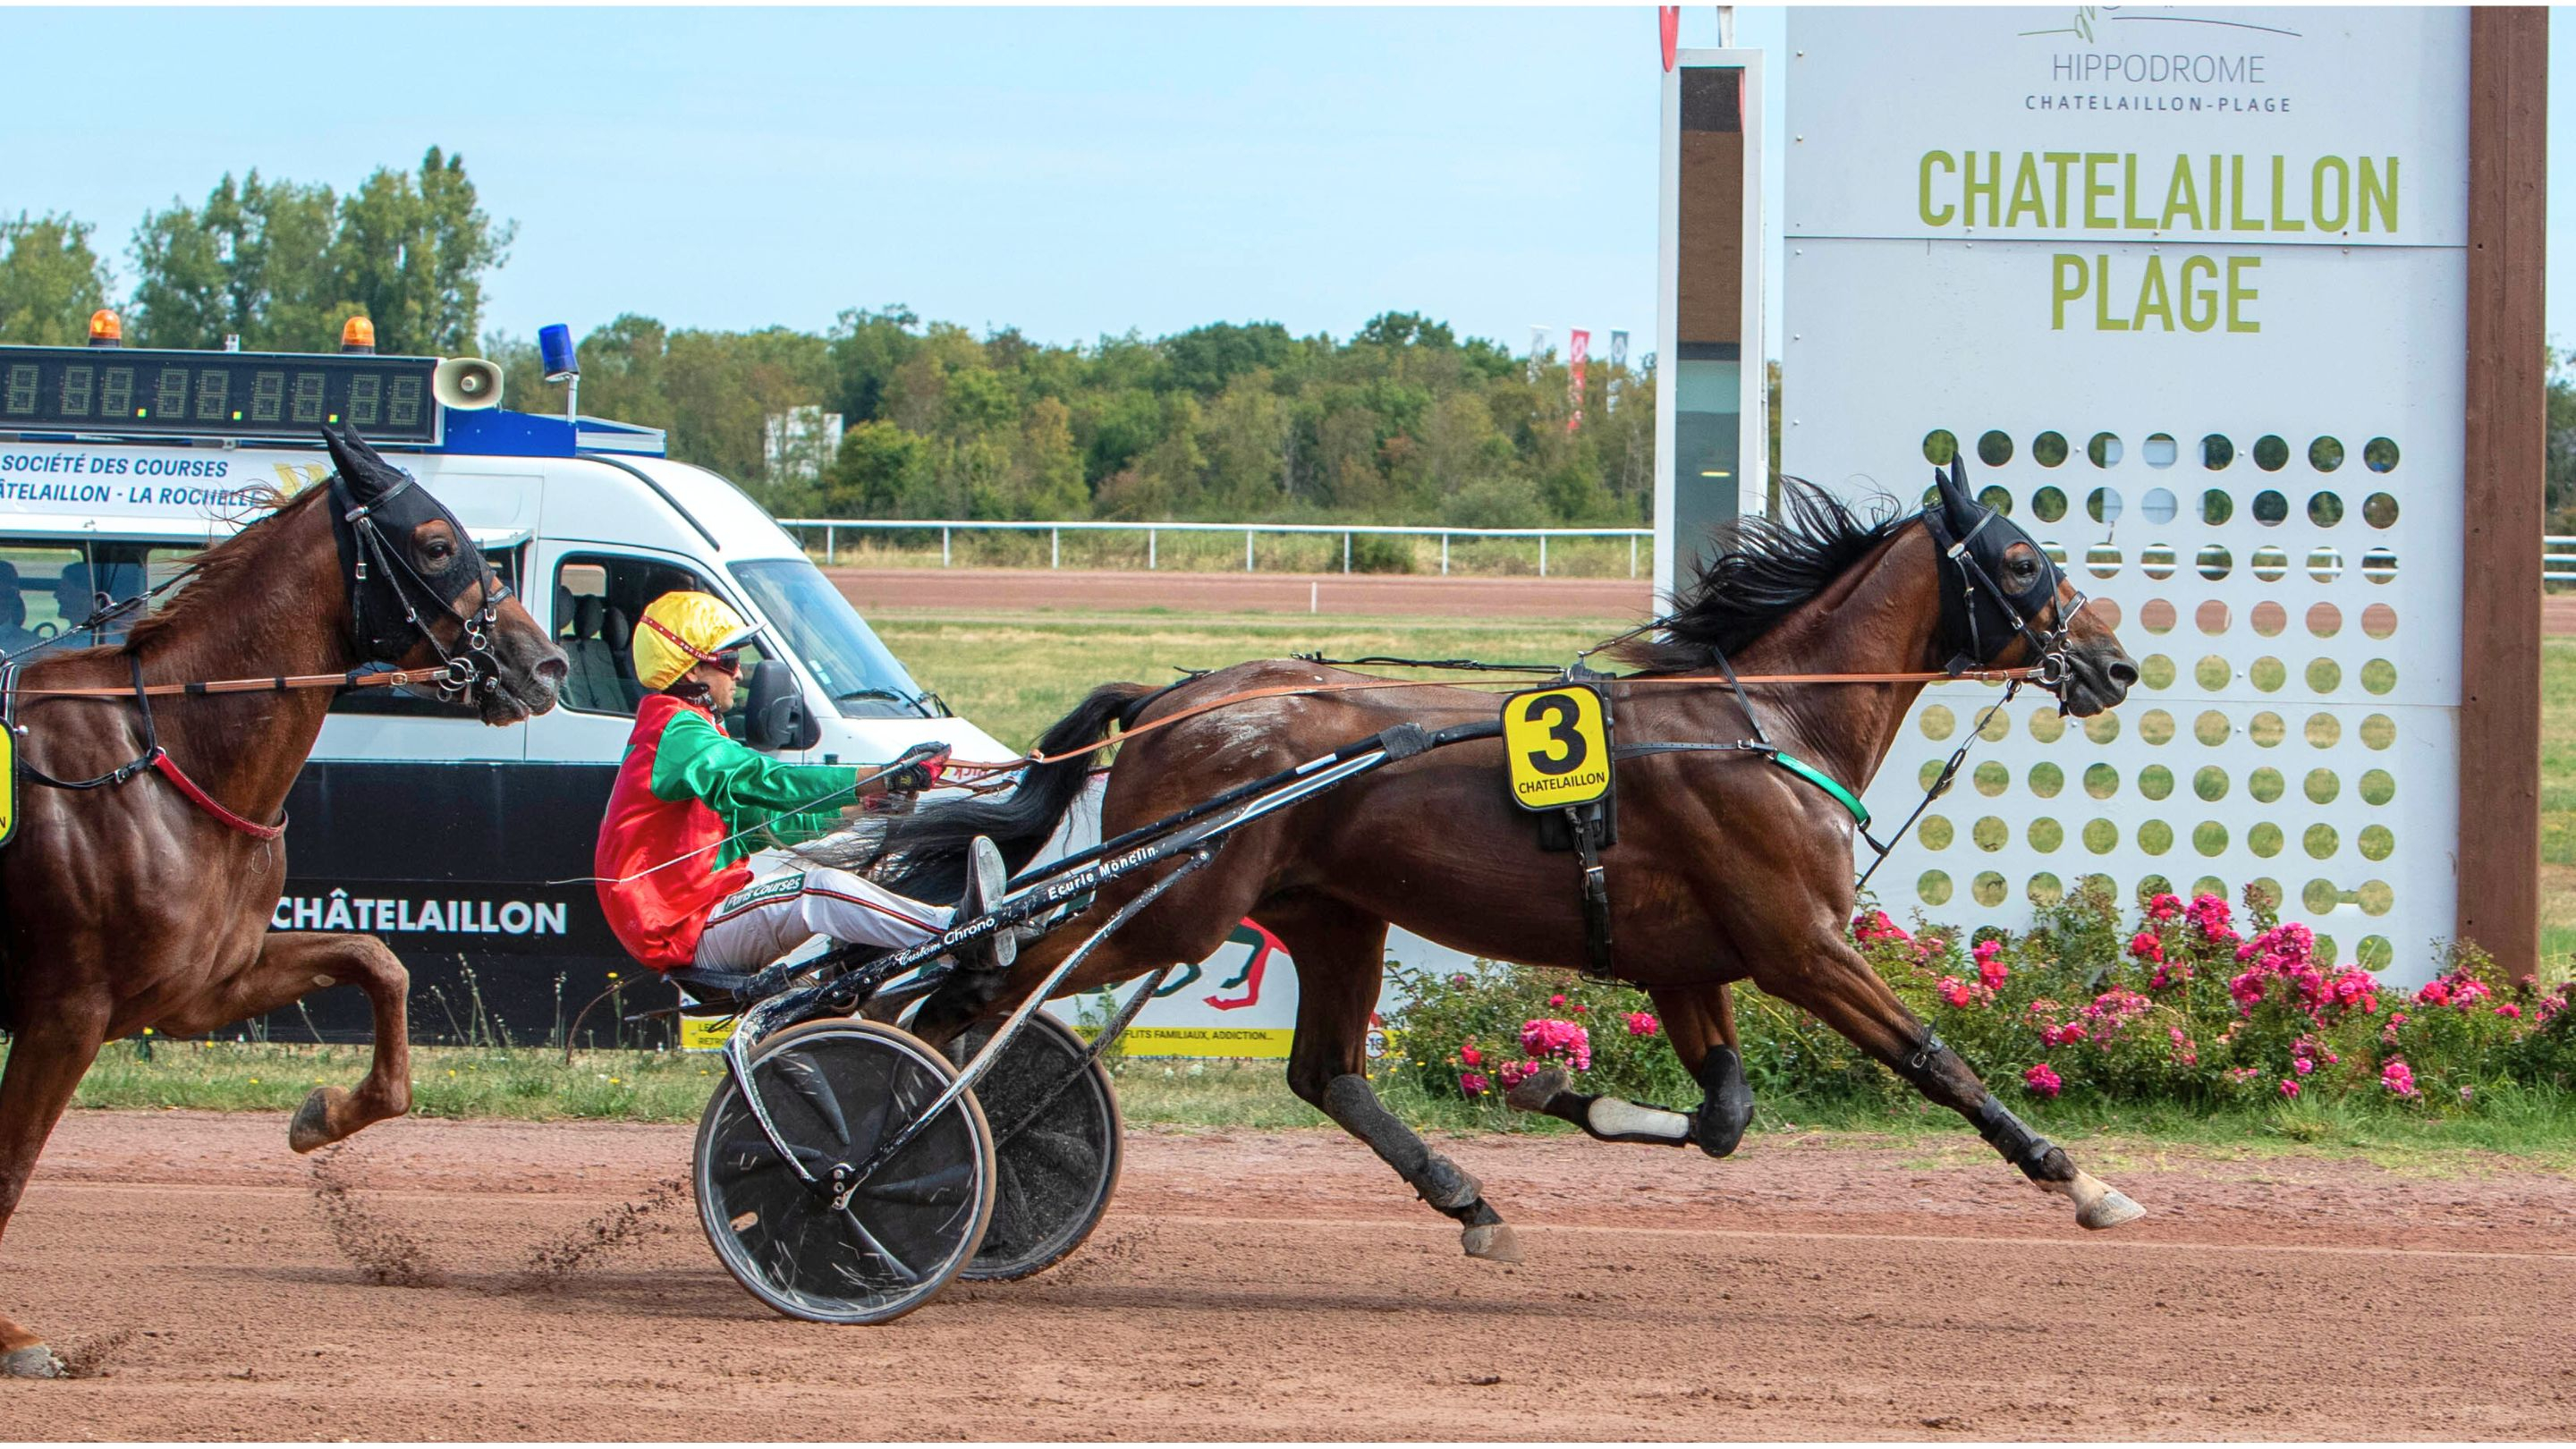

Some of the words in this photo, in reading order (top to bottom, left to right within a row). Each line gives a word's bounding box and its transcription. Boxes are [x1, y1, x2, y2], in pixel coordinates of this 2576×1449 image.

[2053, 54, 2266, 83] HIPPODROME
[2025, 96, 2291, 113] CHATELAILLON-PLAGE
[1918, 150, 2399, 233] CHATELAILLON
[2052, 254, 2262, 333] PLAGE
[2, 453, 86, 473] SOCIÉTÉ
[90, 457, 128, 474] DES
[134, 459, 228, 477] COURSES
[129, 487, 152, 504] LA
[1525, 694, 1587, 775] 3
[1519, 772, 1606, 794] CHATELAILLON
[271, 887, 566, 935] CHÂTELAILLON
[944, 917, 996, 945] Chrono
[1154, 1030, 1209, 1041] FAMILIAUX,
